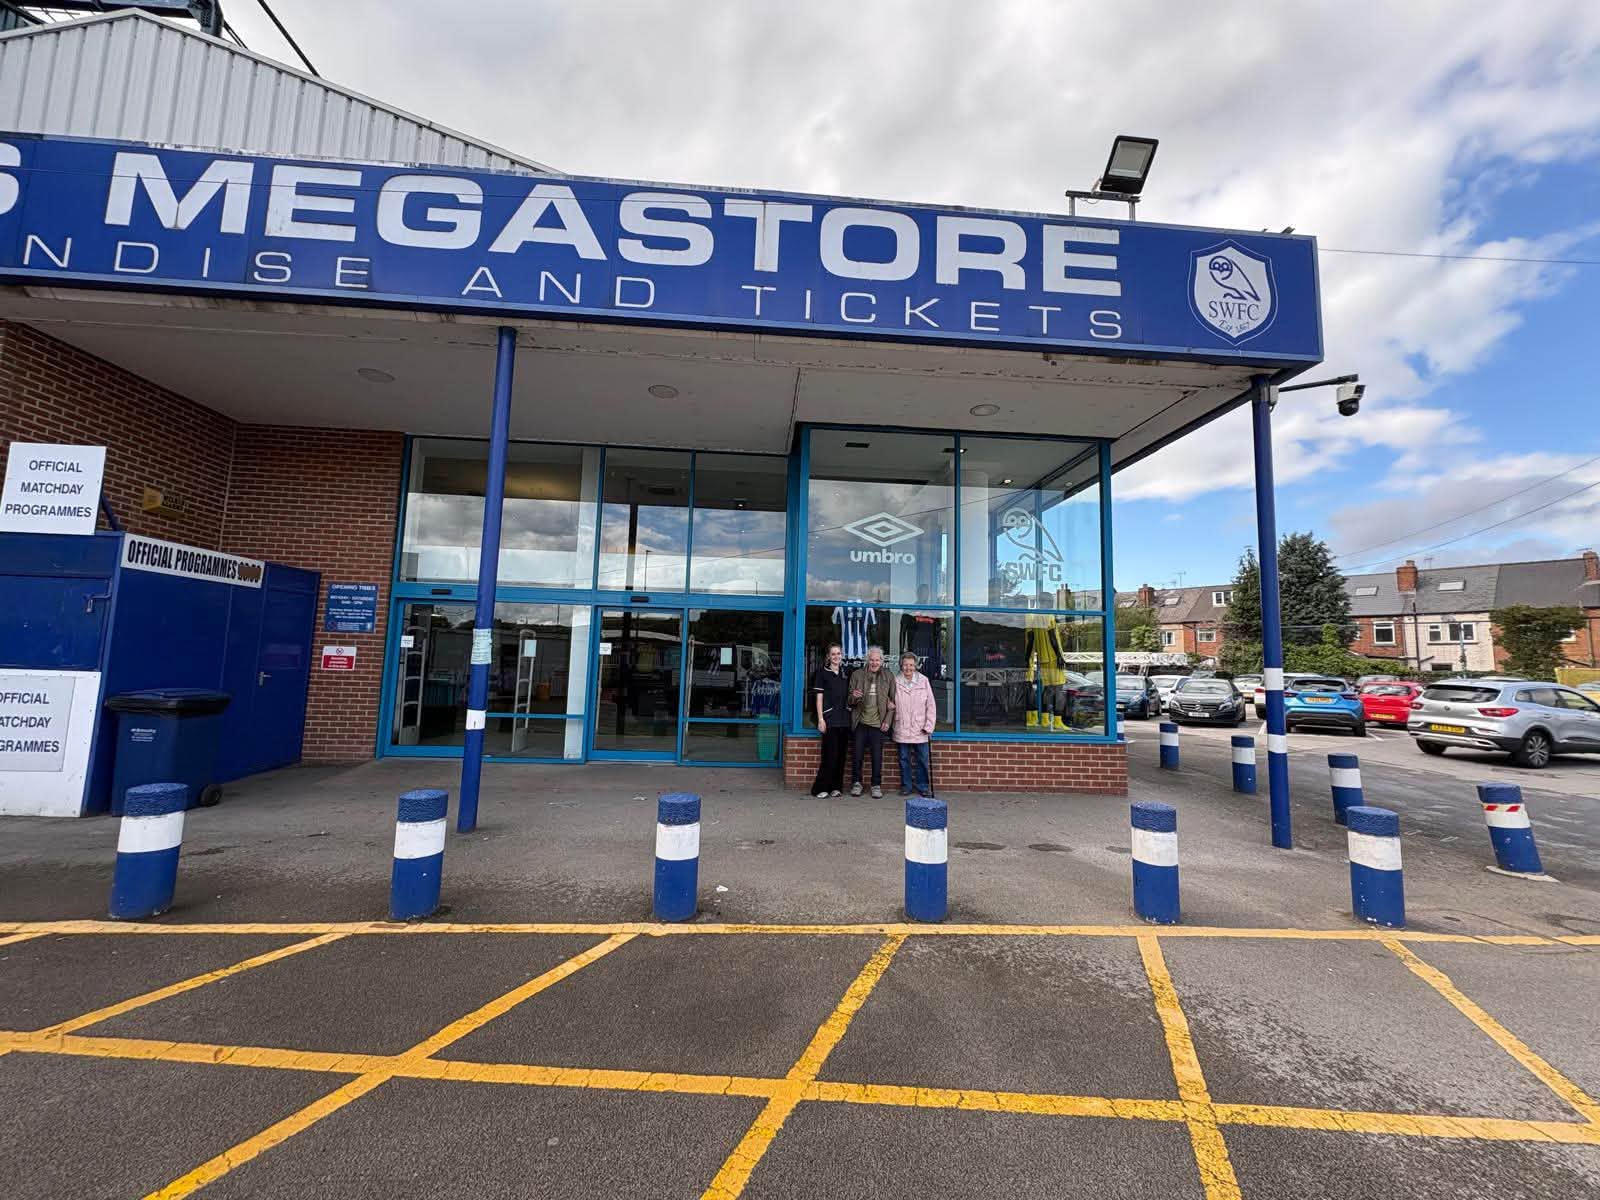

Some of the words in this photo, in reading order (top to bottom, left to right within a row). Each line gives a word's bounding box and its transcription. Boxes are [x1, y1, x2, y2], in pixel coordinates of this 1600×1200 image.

[104, 151, 1122, 297] MEGASTORE
[22, 233, 371, 289] NDISE
[461, 266, 656, 309] AND
[741, 285, 1123, 340] TICKETS
[1208, 300, 1260, 321] SWFC
[29, 460, 83, 473] OFFICIAL
[20, 481, 84, 495] MATCHDAY
[5, 503, 92, 518] PROGRAMMES
[127, 539, 173, 569] OFFICIAL
[174, 549, 238, 580] PROGRAMMES
[850, 549, 916, 565] umbro
[1005, 562, 1062, 582] SWFC
